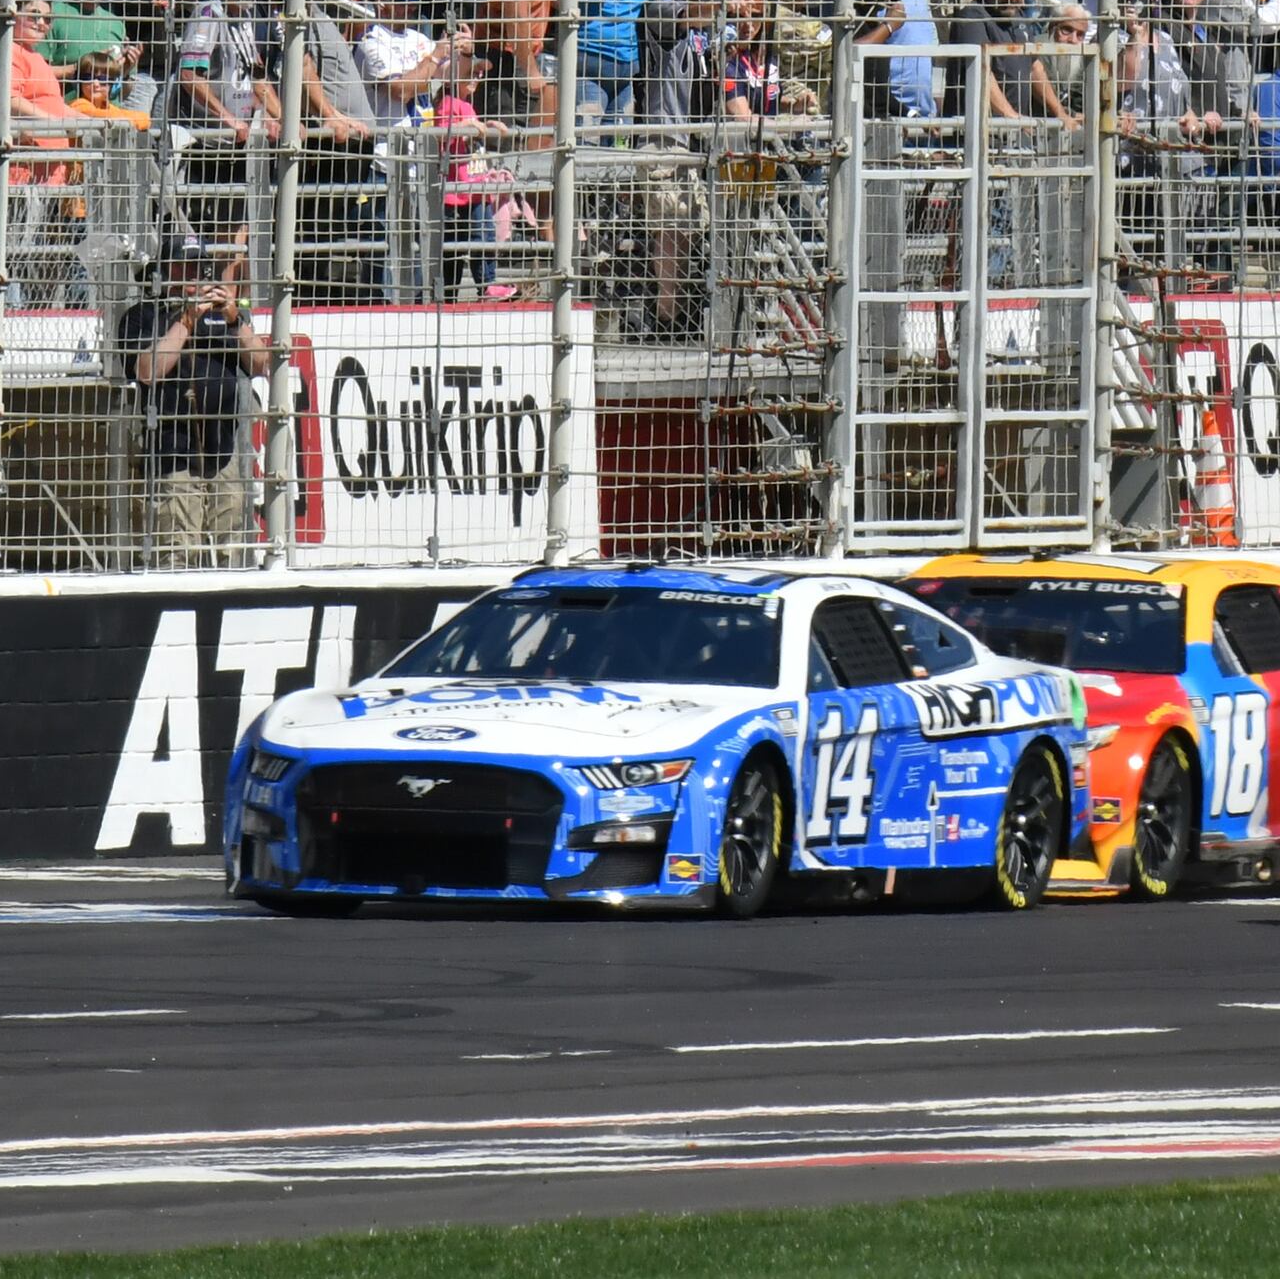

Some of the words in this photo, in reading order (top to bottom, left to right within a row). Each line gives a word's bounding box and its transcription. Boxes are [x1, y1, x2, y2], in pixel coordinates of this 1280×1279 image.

[331, 356, 545, 528] QuikTrip
[658, 591, 763, 607] BRISCOE
[1028, 581, 1092, 592] KYLE
[407, 725, 466, 741] Ford
[1211, 693, 1267, 816] 18
[806, 705, 880, 839] 14
